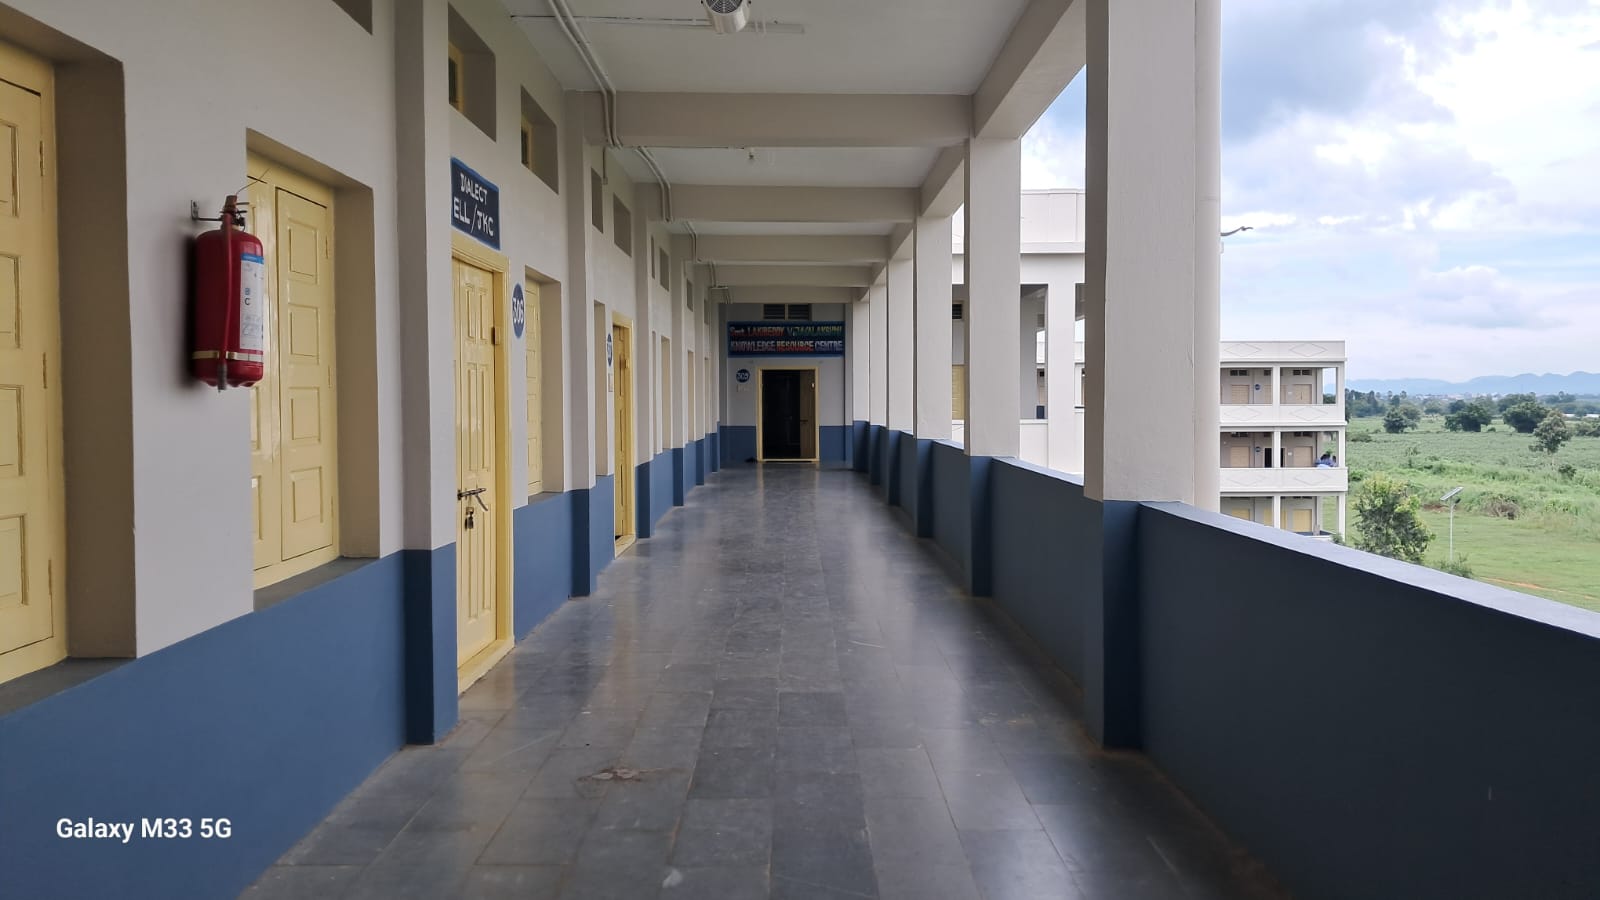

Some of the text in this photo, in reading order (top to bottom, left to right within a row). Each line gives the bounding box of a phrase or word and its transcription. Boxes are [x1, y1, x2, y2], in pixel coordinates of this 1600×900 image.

[460, 172, 488, 205] DIALECT
[731, 340, 843, 352] KNOWLEDGE RESOURCE CENTRE
